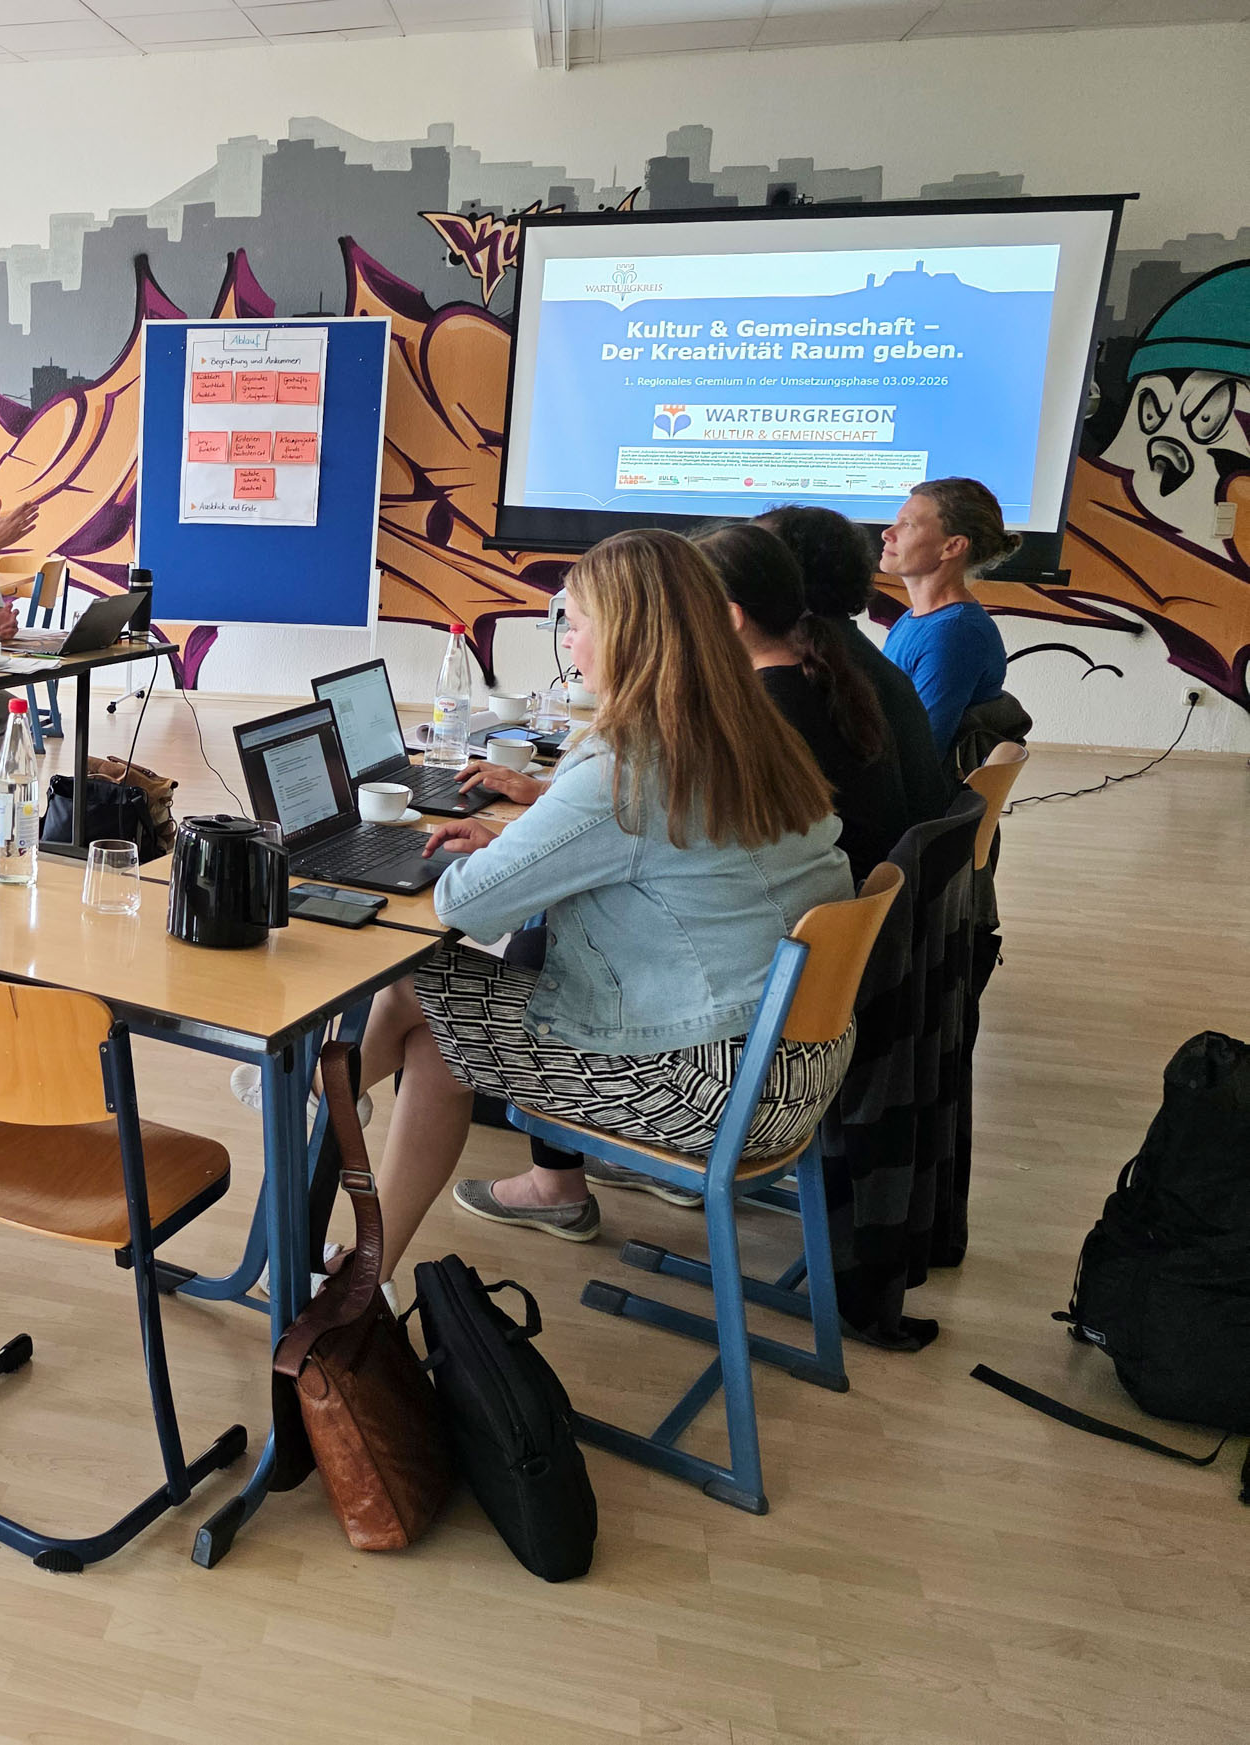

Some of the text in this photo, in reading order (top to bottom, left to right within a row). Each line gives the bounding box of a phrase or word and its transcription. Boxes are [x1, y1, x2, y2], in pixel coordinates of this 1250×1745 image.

[585, 283, 663, 293] WARTBURGKREIS
[626, 320, 703, 339] Kultur
[709, 320, 729, 338] &
[736, 317, 916, 338] Gemeinschaft
[230, 333, 261, 348] Ablauf
[601, 340, 964, 363] Der Kreativität Raum geben.
[250, 356, 263, 364] und
[624, 376, 949, 388] 1. Regionales Gremium in der Umsetzungsphase 03.09.2026
[705, 408, 896, 423] WARTBURGREGION
[703, 428, 878, 441] KULTUR & GEMEINSCHAFT
[228, 503, 240, 511] und
[241, 503, 259, 513] Ende
